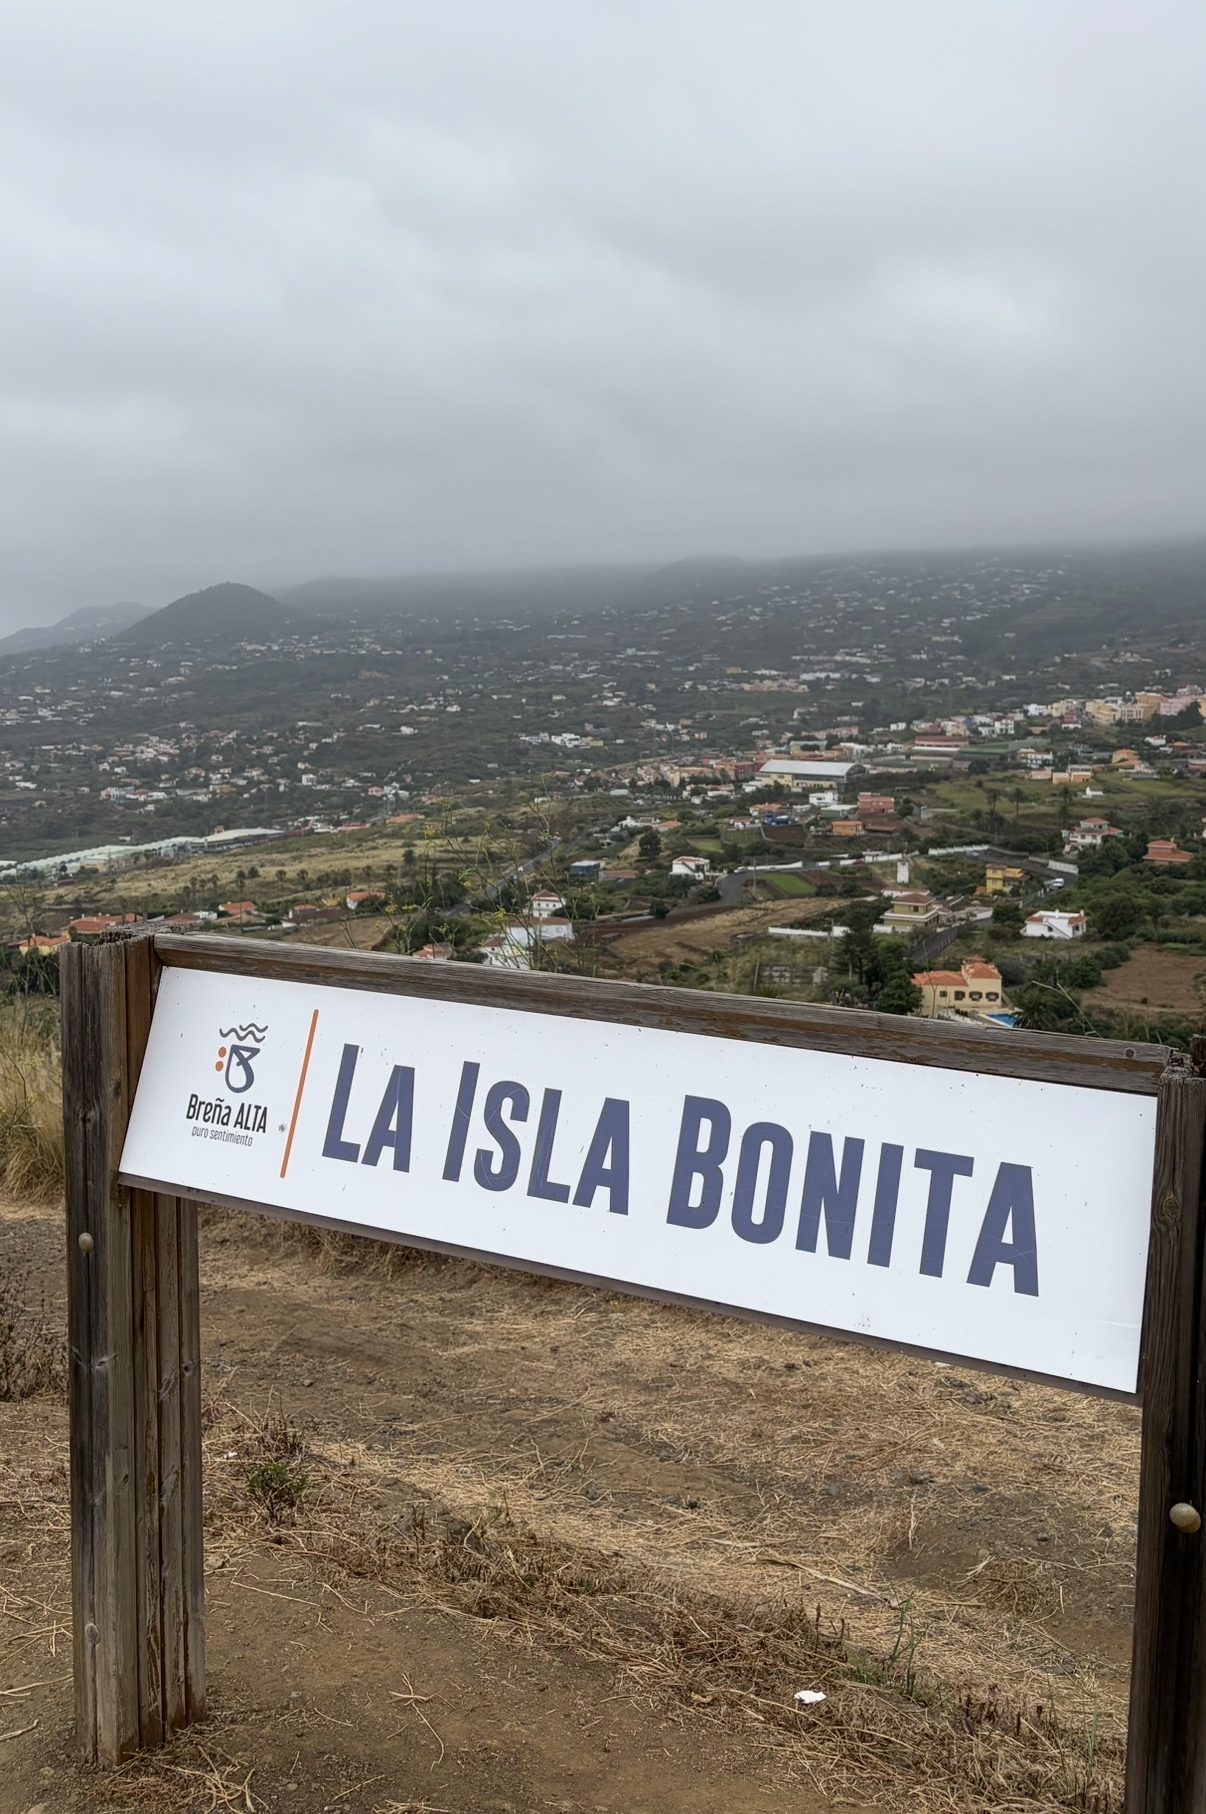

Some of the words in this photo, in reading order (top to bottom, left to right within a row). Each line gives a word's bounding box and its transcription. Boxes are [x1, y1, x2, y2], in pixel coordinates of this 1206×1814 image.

[186, 1094, 232, 1126] Breña
[234, 1102, 268, 1133] ALTA
[192, 1126, 208, 1138] puro
[209, 1129, 253, 1146] sentimiento
[322, 1043, 415, 1173] LA
[442, 1061, 630, 1216] ISLA
[666, 1094, 1039, 1297] BONITA
